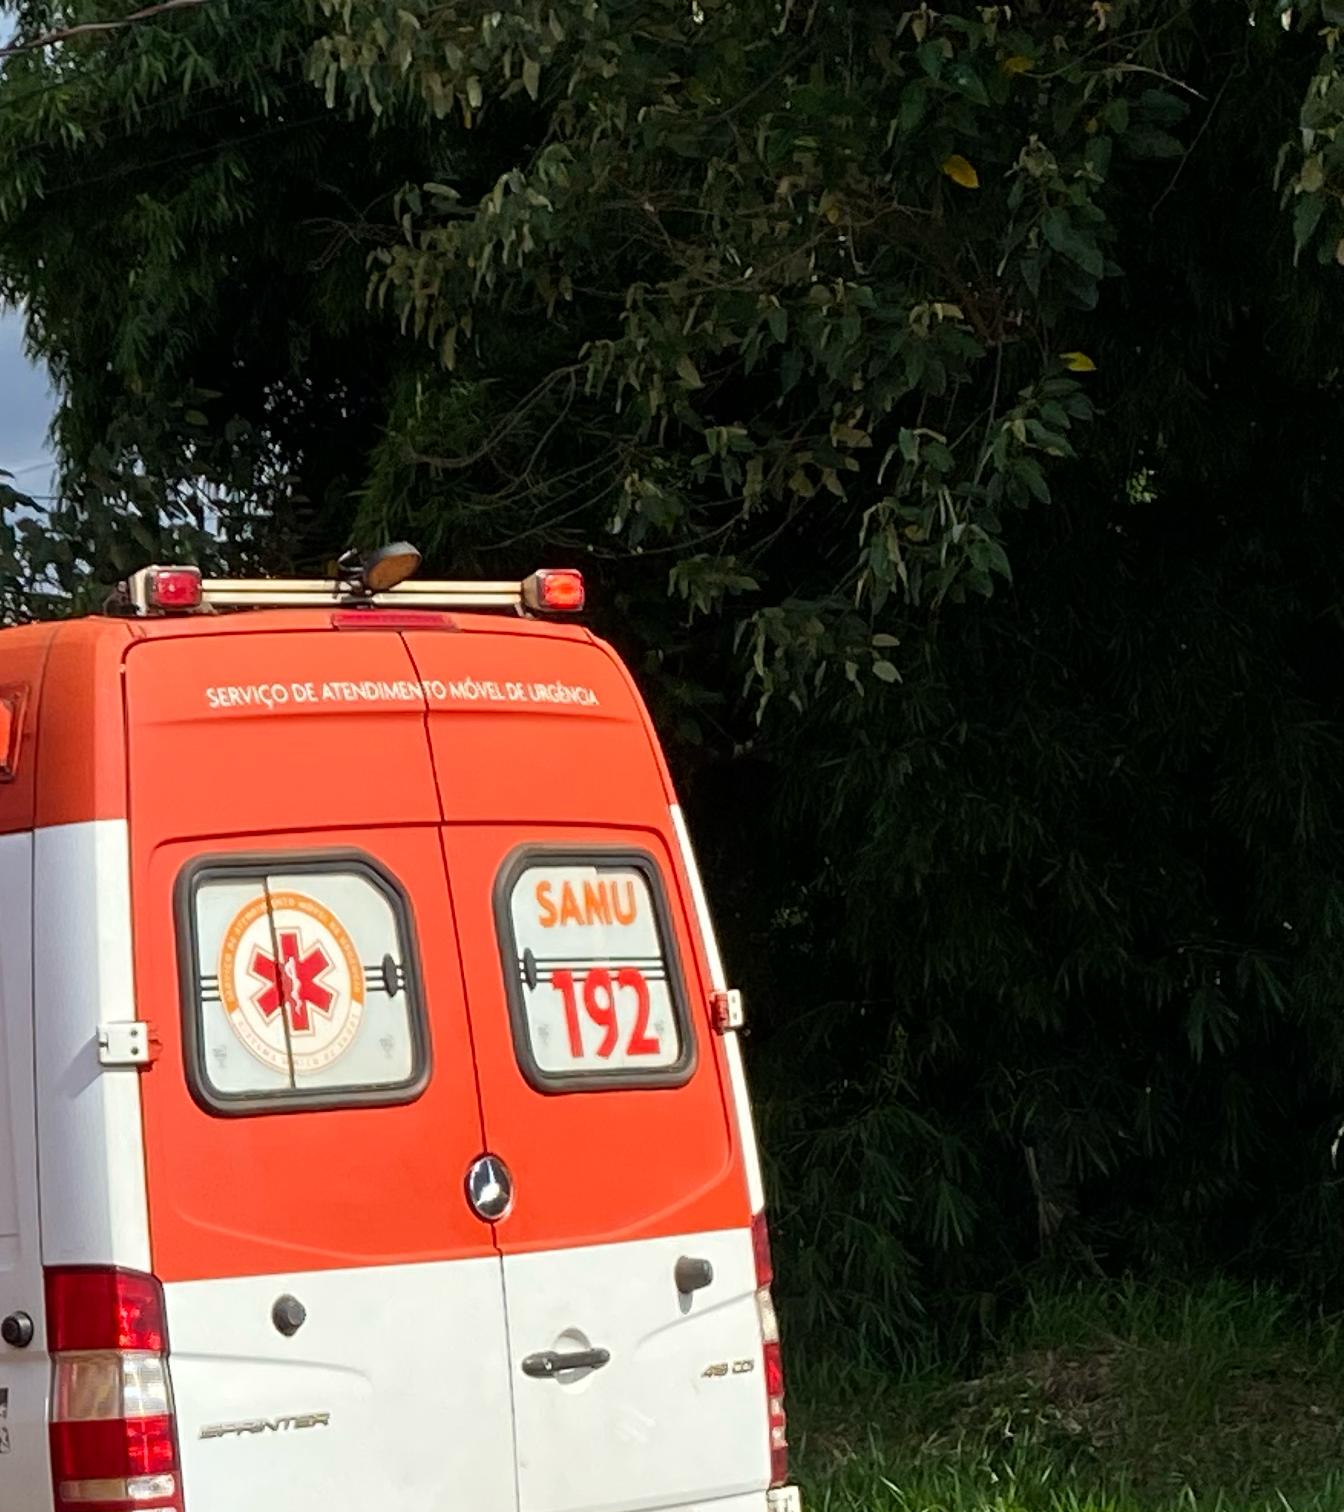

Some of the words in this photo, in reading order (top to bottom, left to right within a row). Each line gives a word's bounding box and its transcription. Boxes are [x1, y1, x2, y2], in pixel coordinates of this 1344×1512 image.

[206, 684, 288, 709] SERVIÇO
[291, 682, 318, 704] DE
[322, 680, 446, 701] ATENDIMENTO
[449, 676, 506, 700] MÓVEL
[506, 682, 528, 701] DE
[529, 680, 600, 706] URGÊNCIA
[536, 880, 637, 928] SAMU
[551, 967, 660, 1060] 192
[199, 1412, 330, 1439] SPRINTER
